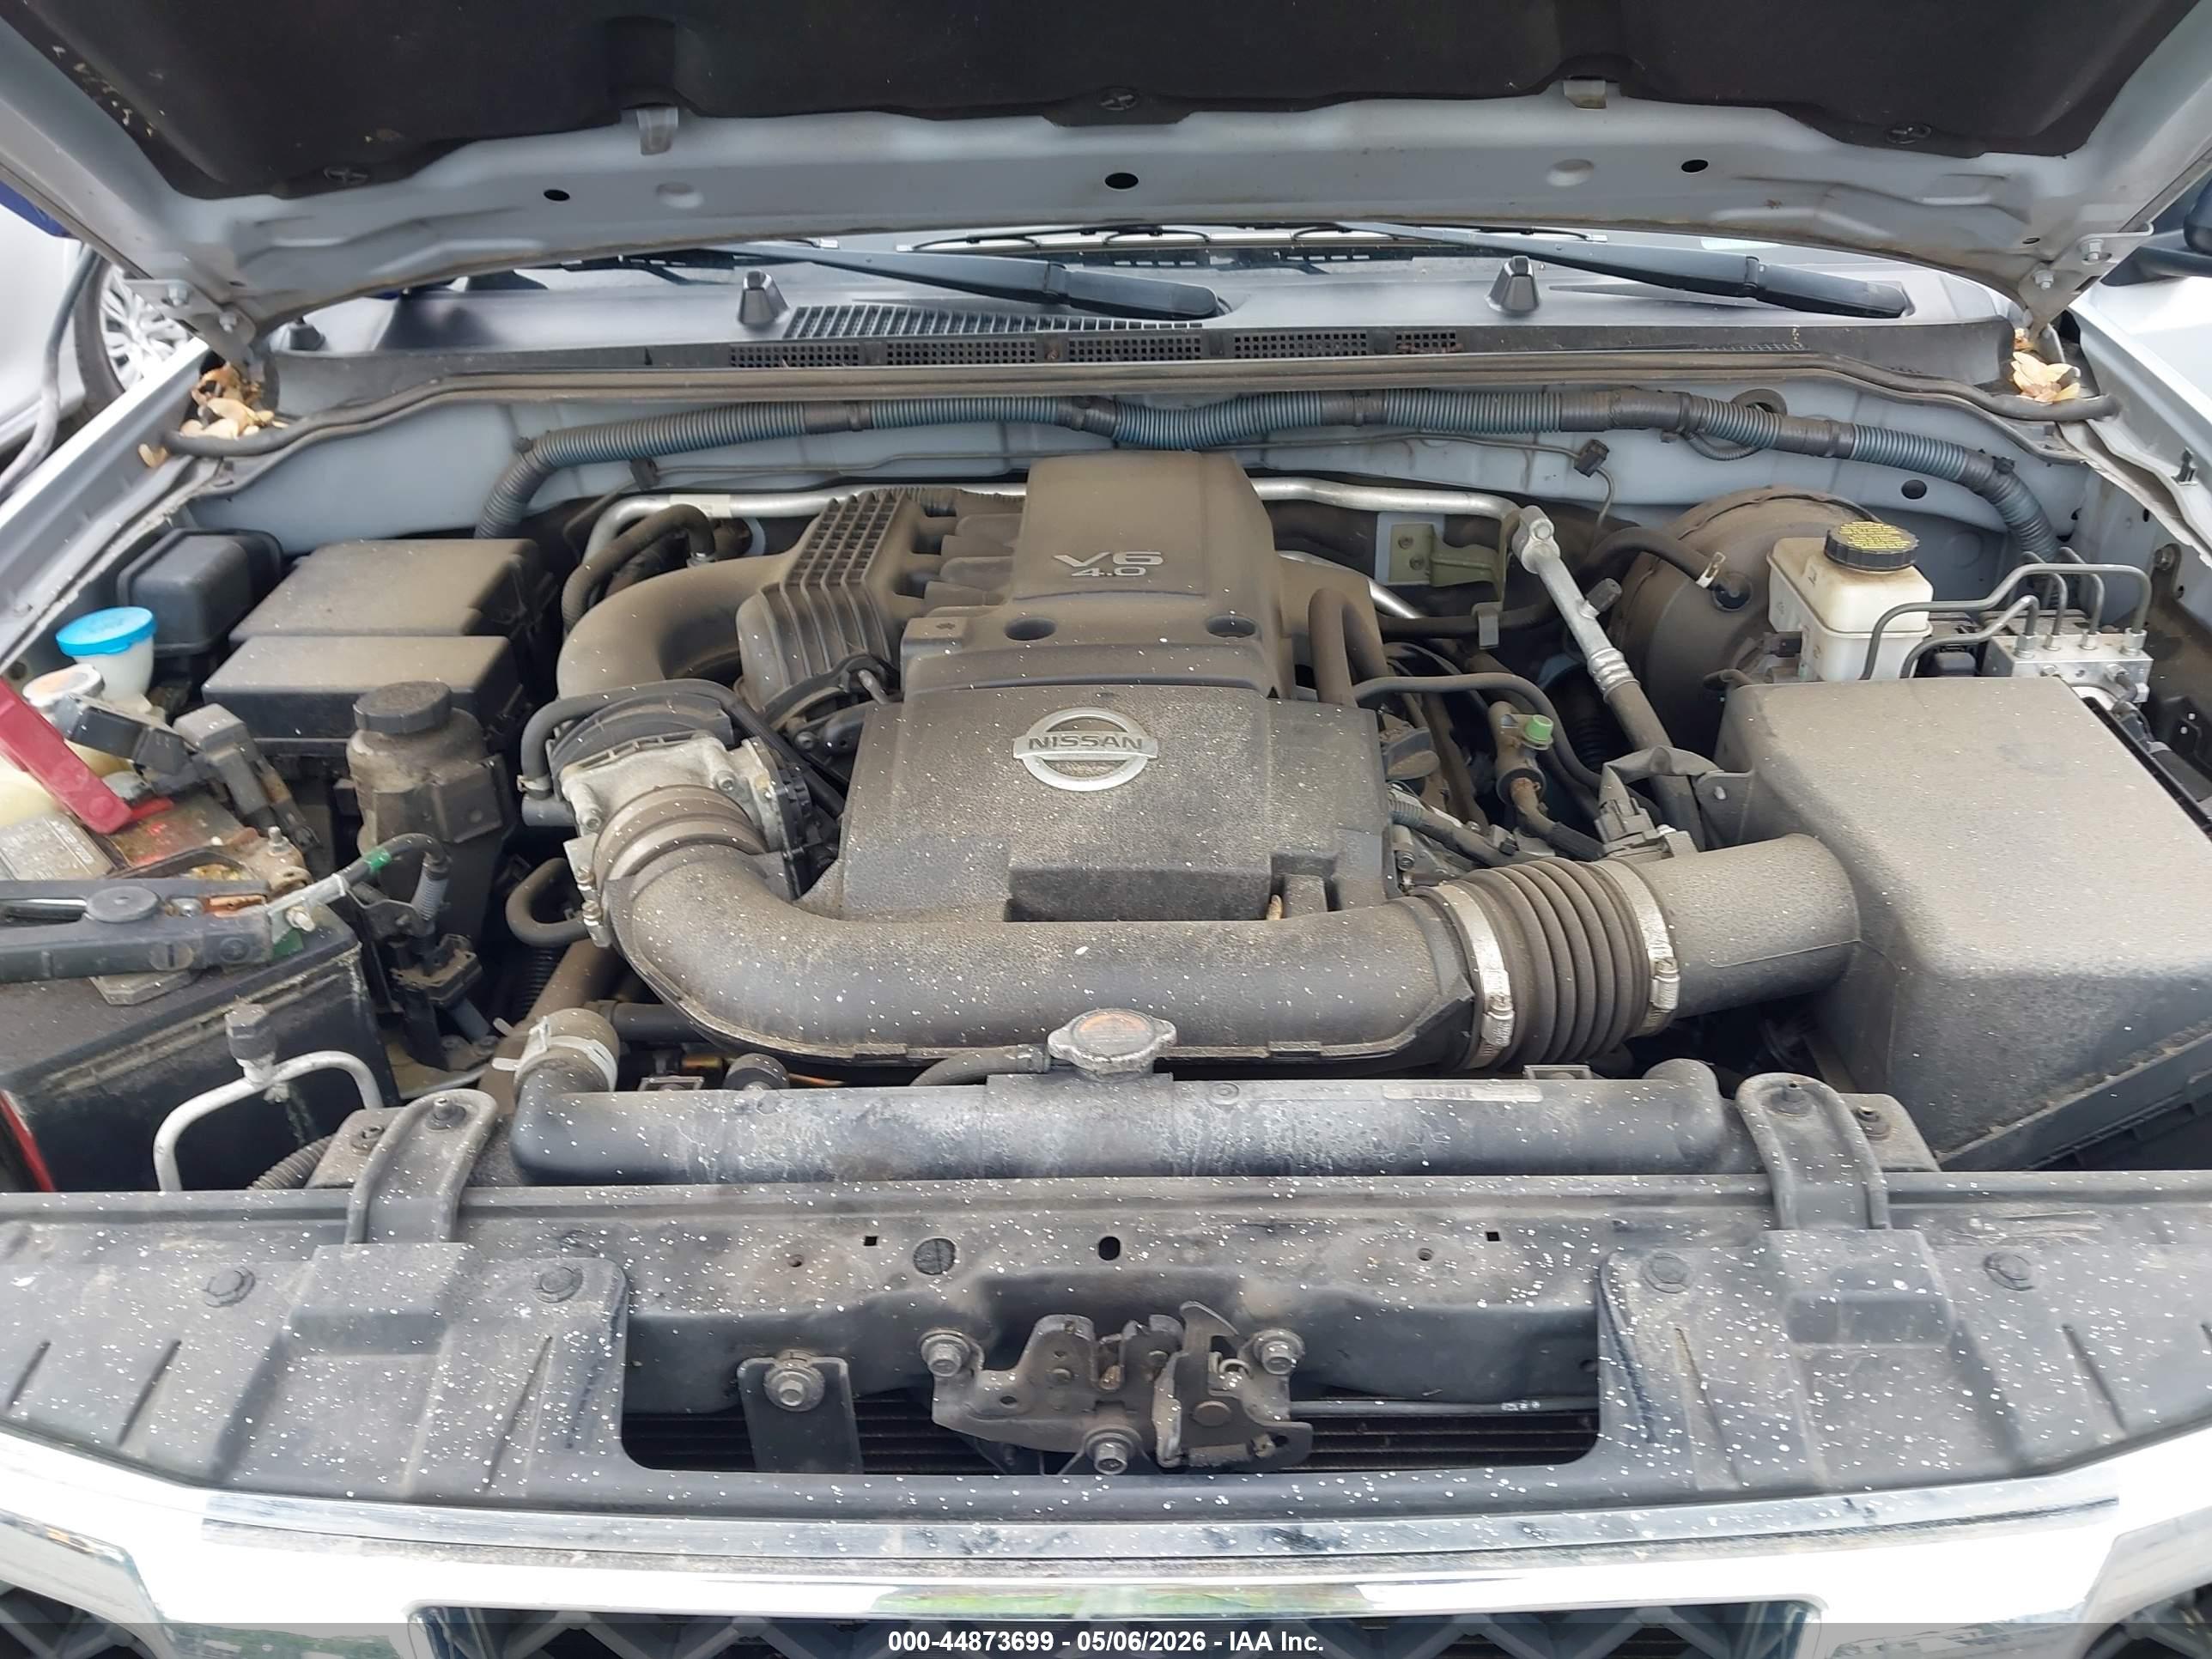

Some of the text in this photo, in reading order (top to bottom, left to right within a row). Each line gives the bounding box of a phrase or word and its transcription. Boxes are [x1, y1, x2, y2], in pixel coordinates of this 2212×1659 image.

[1053, 551, 1164, 568] V6
[1071, 567, 1146, 577] 4.0
[1029, 735, 1143, 750] NISSAN
